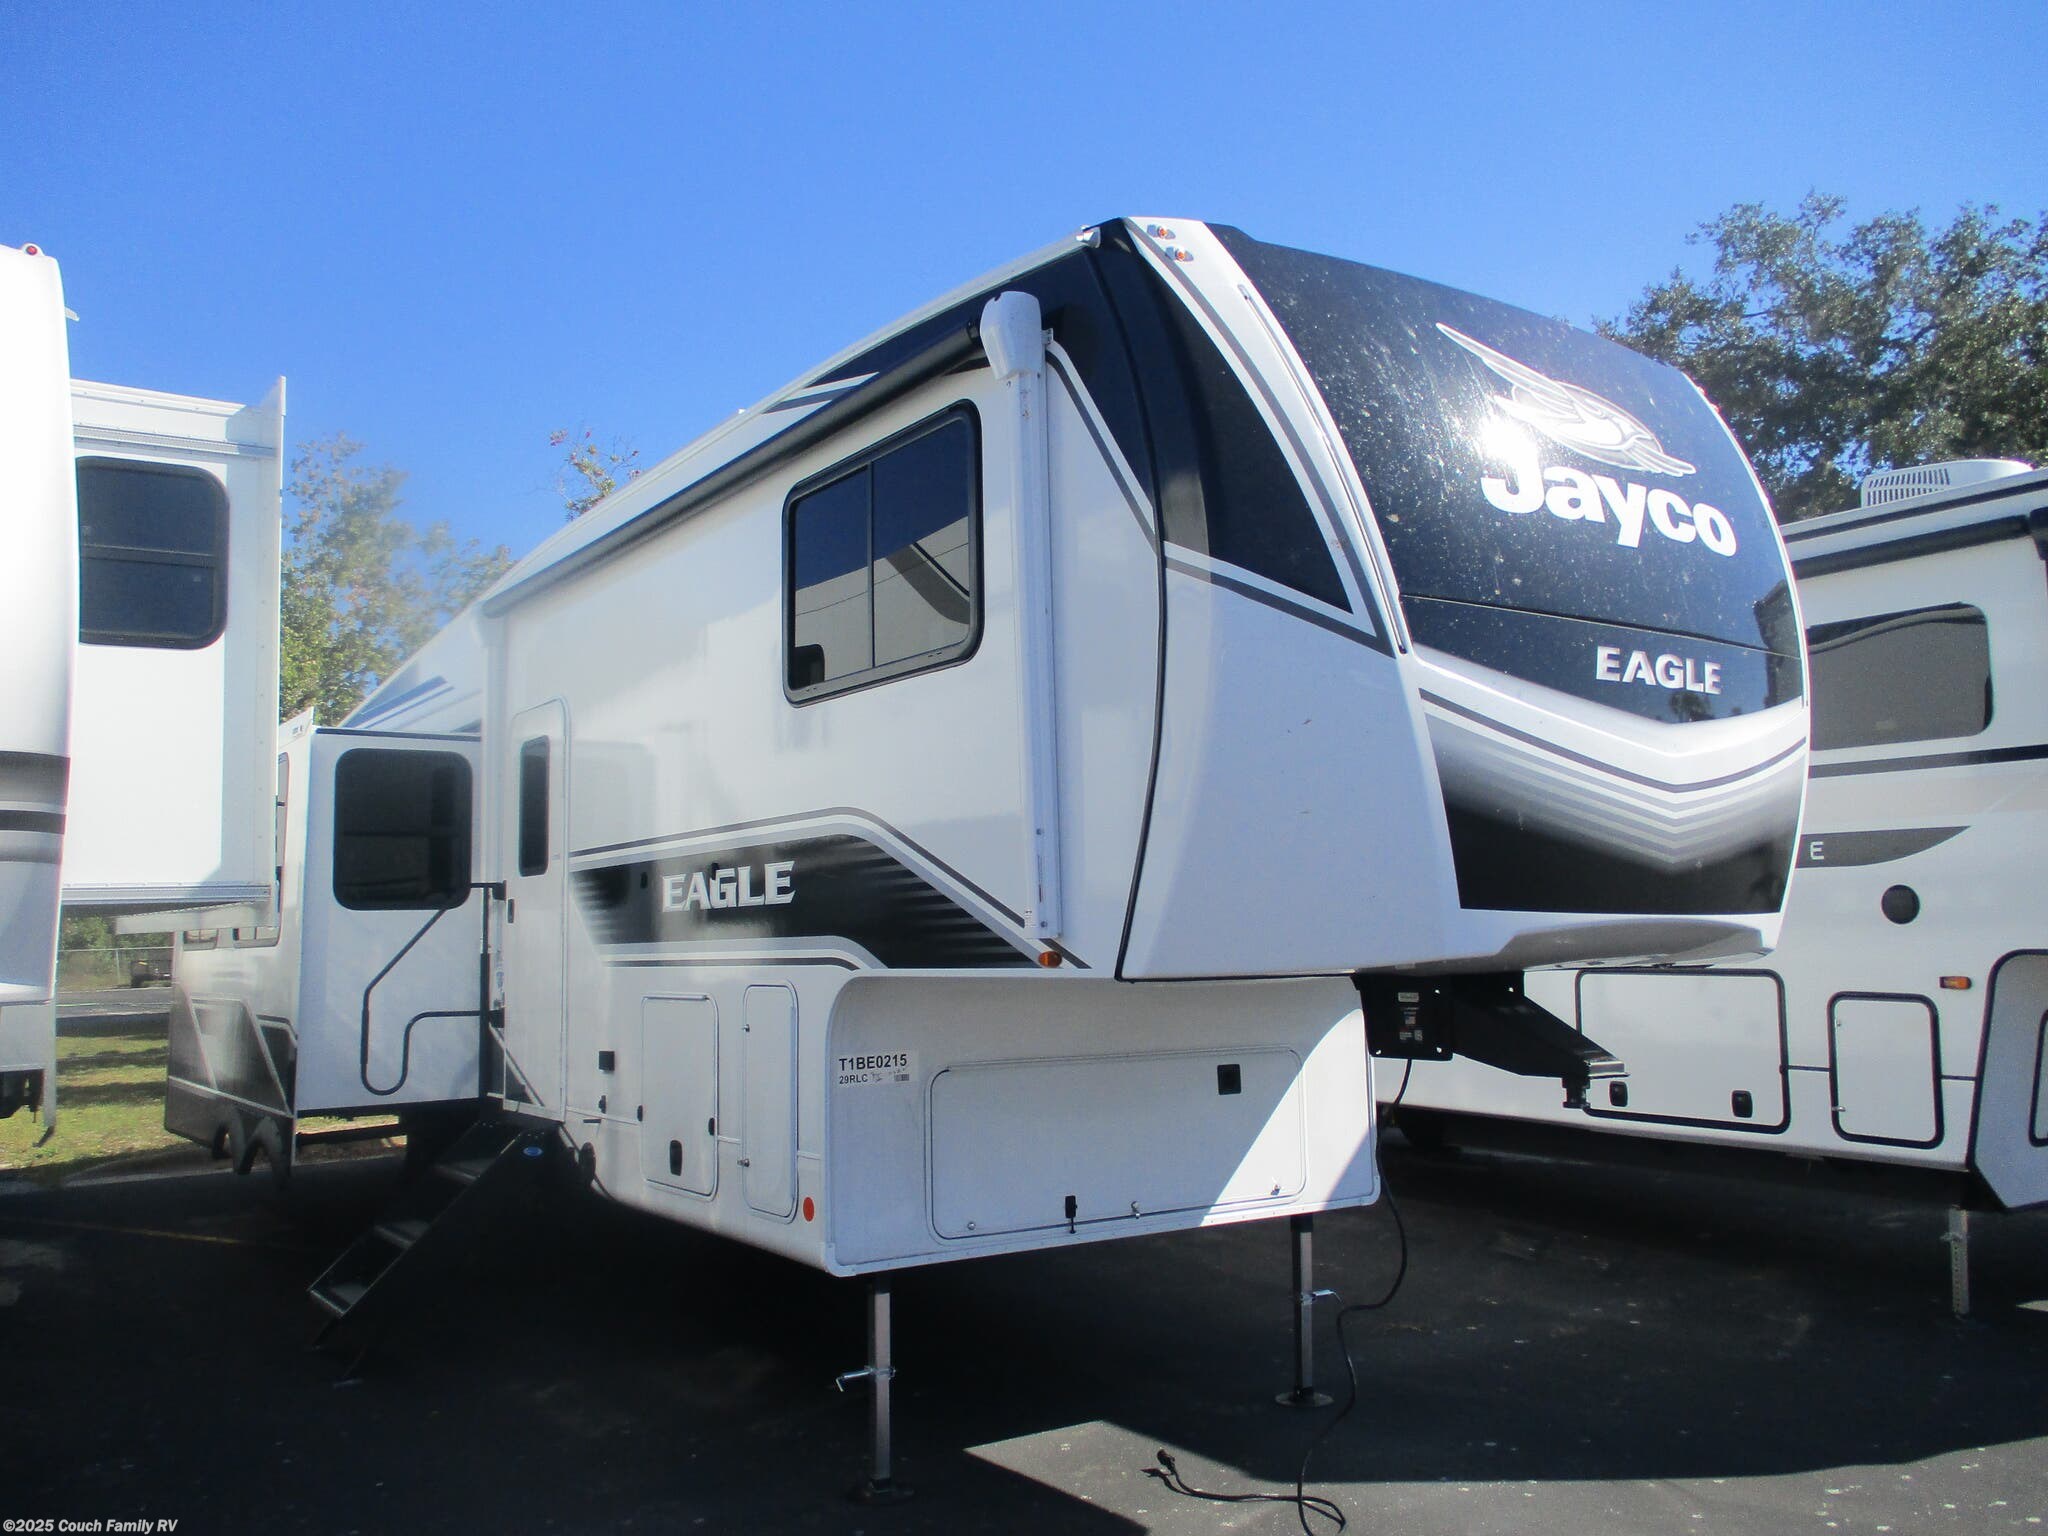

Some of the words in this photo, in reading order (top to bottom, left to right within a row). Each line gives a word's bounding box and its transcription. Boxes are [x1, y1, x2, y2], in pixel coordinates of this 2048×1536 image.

[1480, 438, 1737, 557] Jayco
[1595, 646, 1722, 694] EAGLE
[662, 861, 796, 913] EAGLE
[839, 1053, 907, 1071] T1BE0215
[839, 1074, 868, 1084] 29RLC
